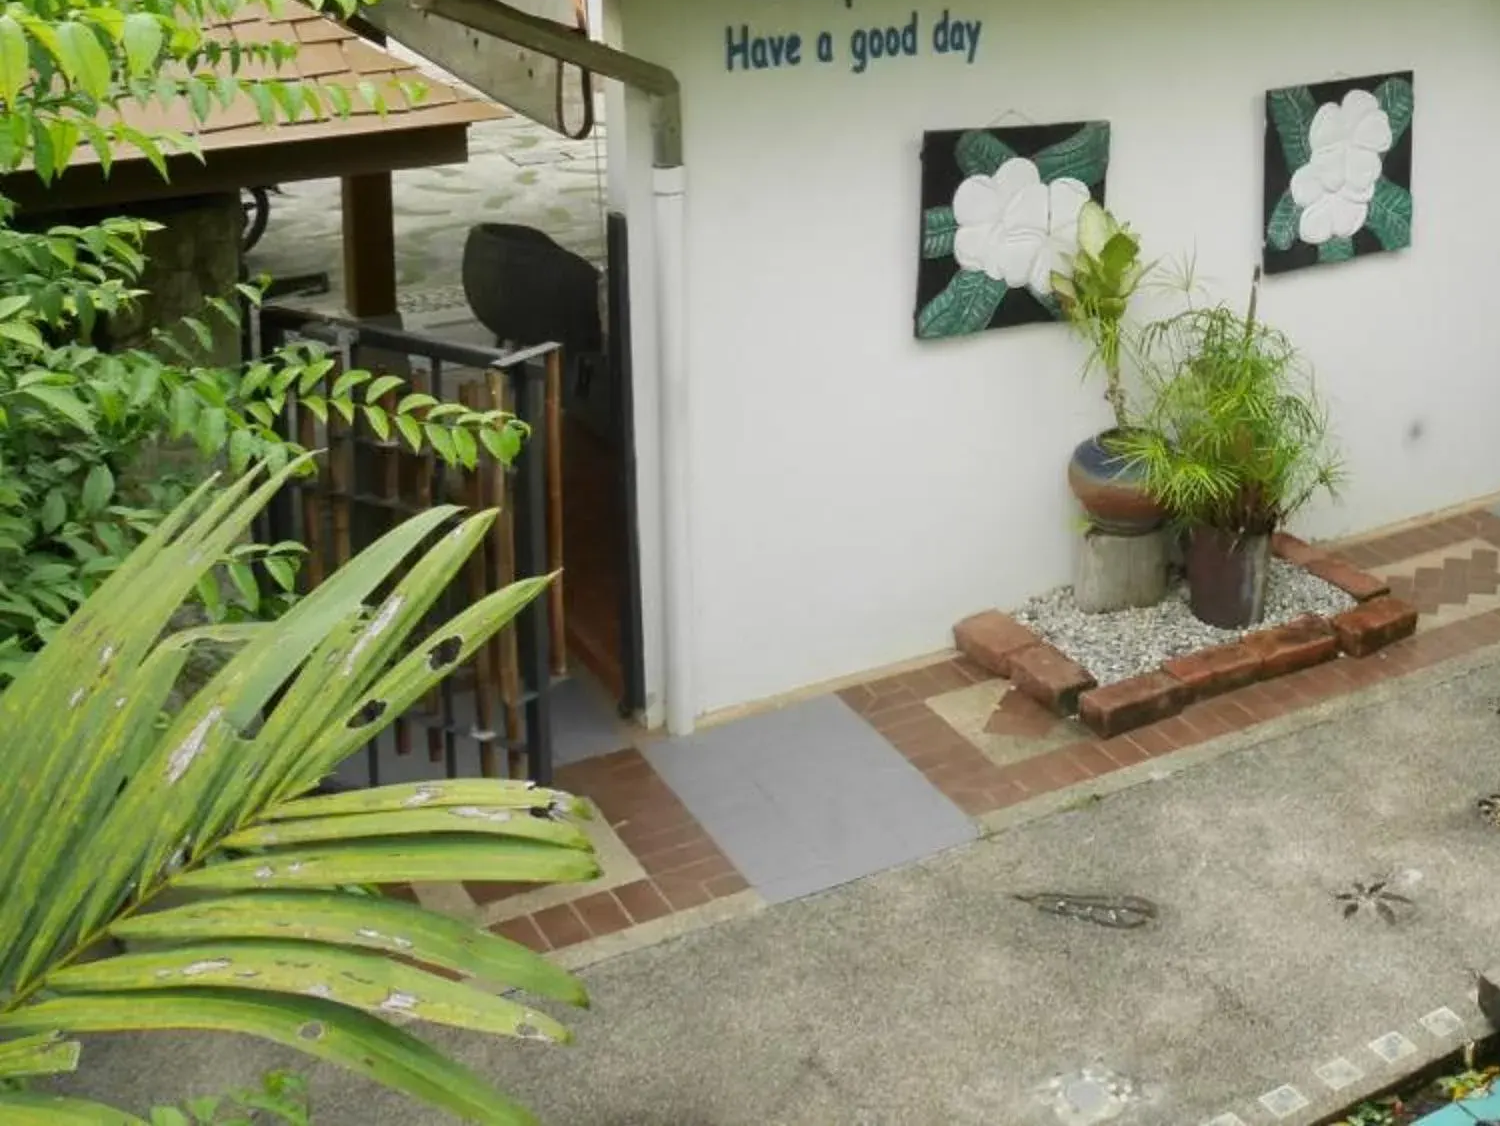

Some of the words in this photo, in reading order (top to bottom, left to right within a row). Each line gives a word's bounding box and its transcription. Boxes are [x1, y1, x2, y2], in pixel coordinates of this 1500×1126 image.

[726, 25, 802, 71] Have
[817, 31, 833, 63] a
[851, 11, 918, 73] good
[933, 10, 982, 64] day
